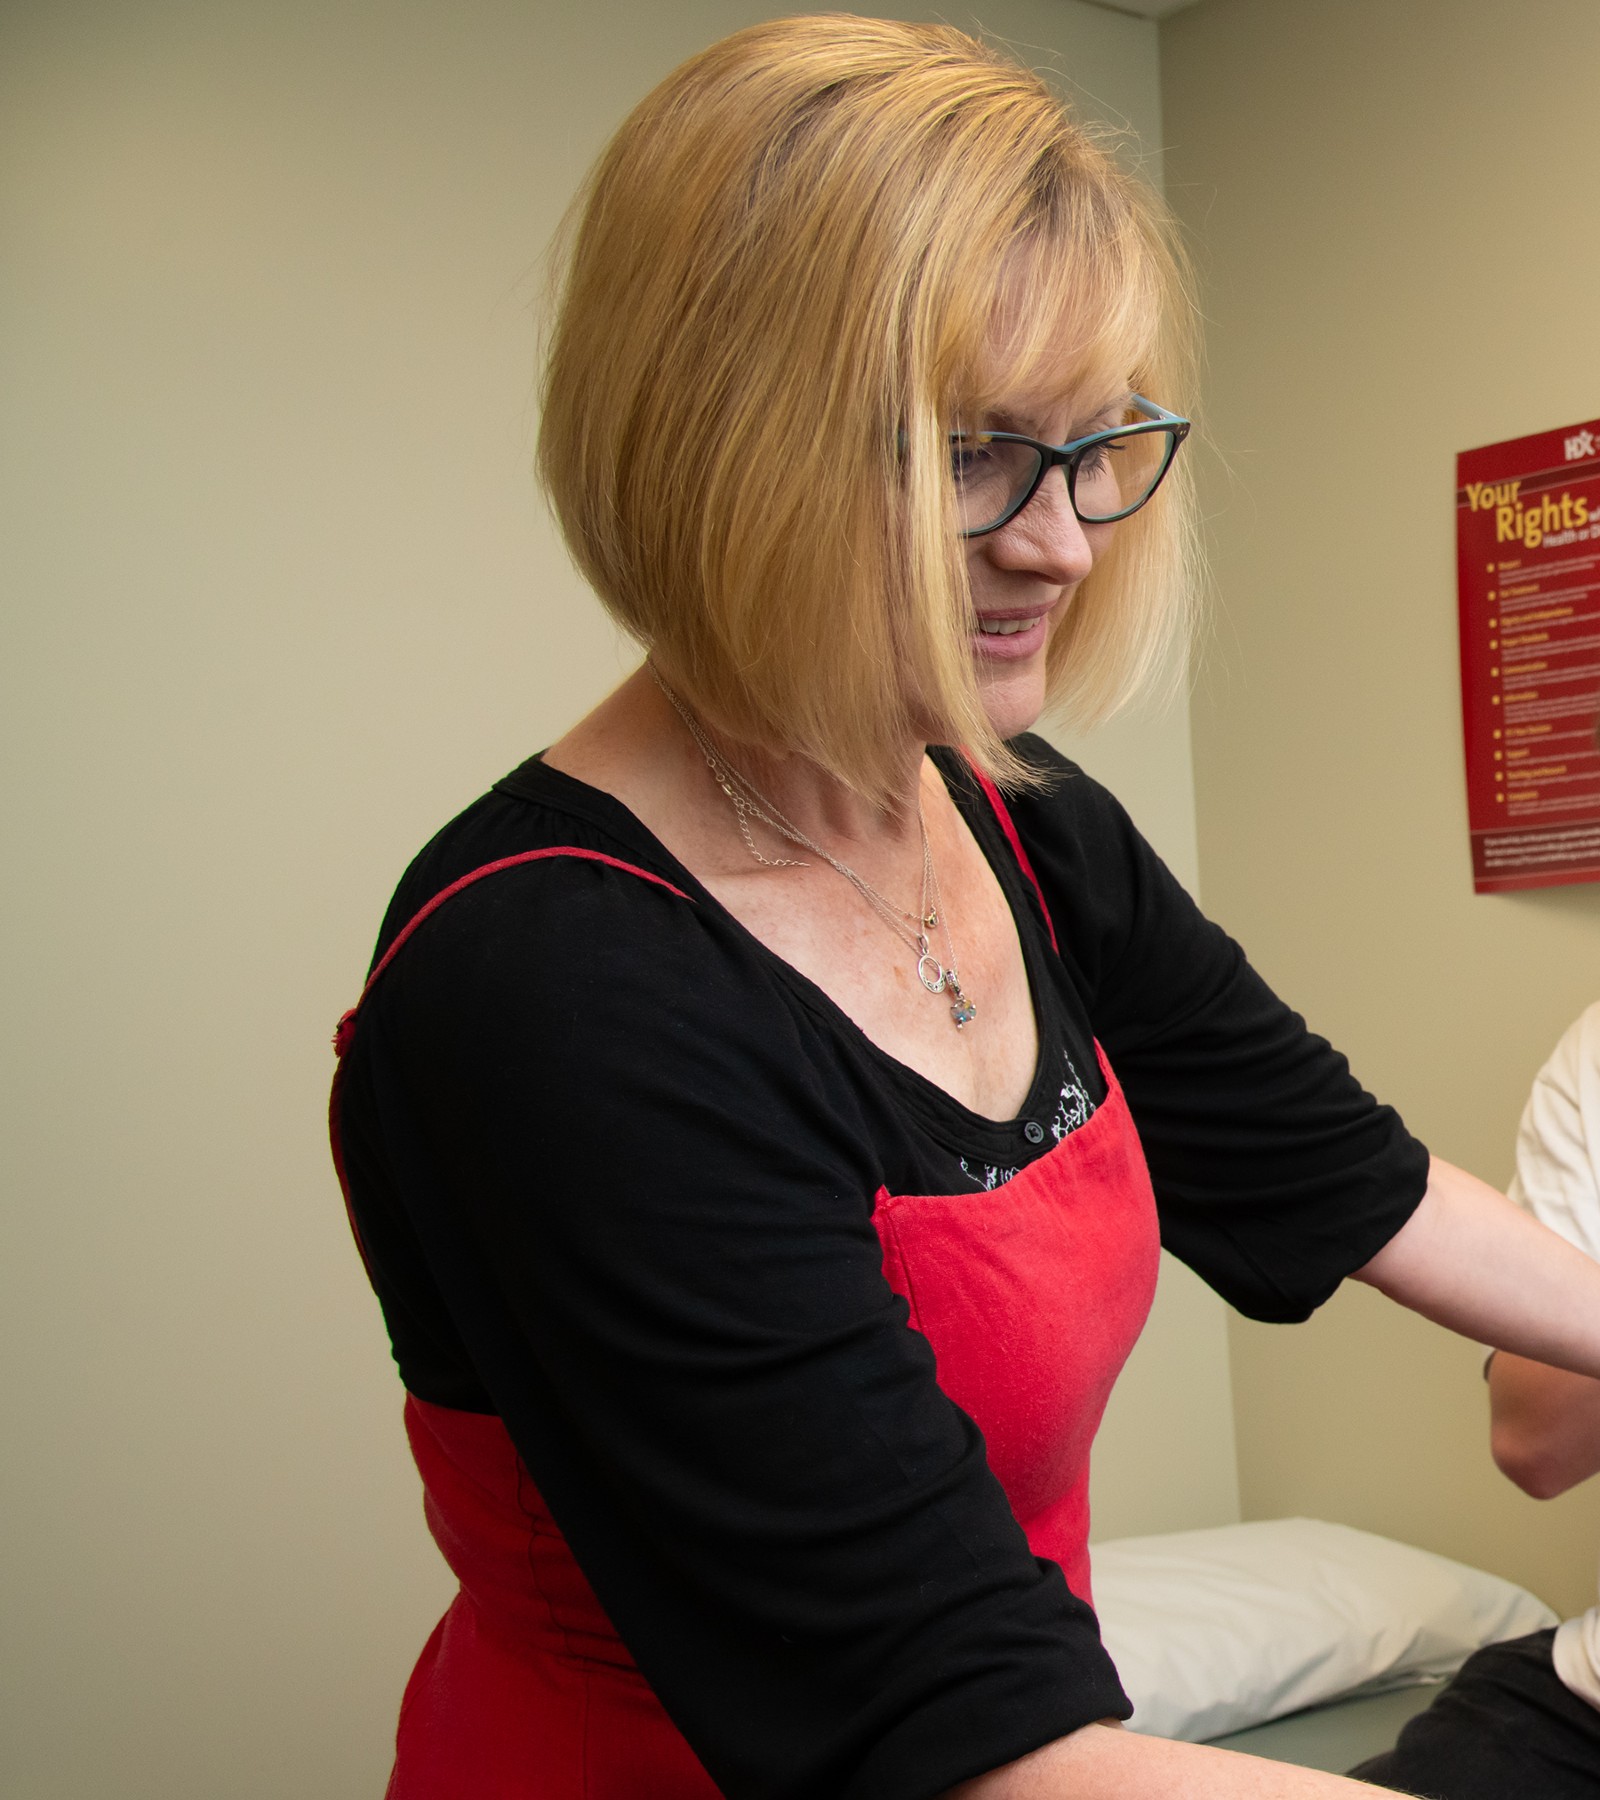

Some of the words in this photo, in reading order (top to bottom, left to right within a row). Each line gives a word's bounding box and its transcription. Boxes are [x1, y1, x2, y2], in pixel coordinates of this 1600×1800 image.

[1465, 480, 1522, 513] Your
[1496, 491, 1590, 549] Rights
[1542, 529, 1578, 548] Health
[1578, 528, 1590, 541] or
